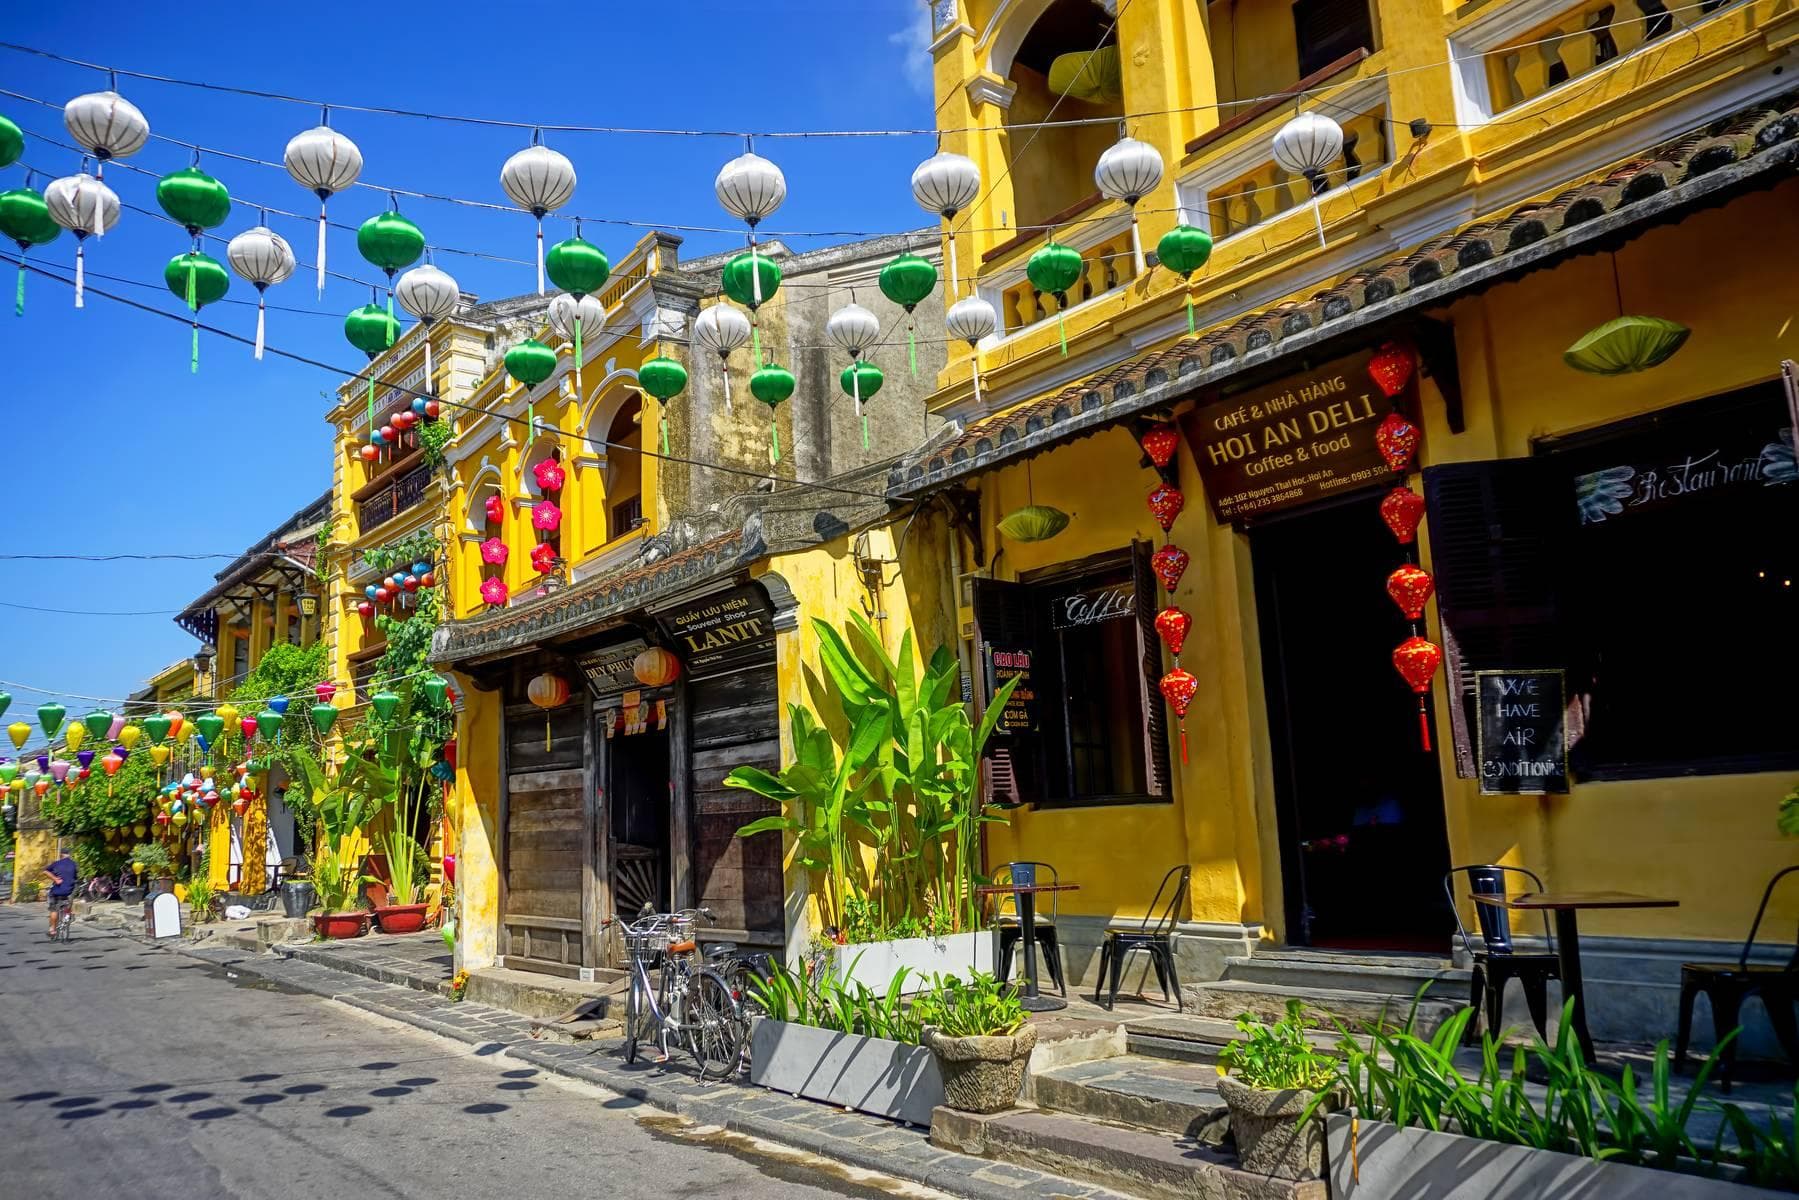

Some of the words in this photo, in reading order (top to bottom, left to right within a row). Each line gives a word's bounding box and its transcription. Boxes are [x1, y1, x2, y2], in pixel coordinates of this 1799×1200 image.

[1214, 407, 1249, 432] CAFÉ
[1251, 404, 1264, 420] &
[1265, 390, 1299, 415] NHÀ
[1299, 376, 1346, 402] HÀNG
[1208, 427, 1257, 466] HOI
[1264, 418, 1301, 450] AN
[1308, 394, 1377, 434] DELI
[1245, 454, 1294, 477] Coffee
[1296, 447, 1310, 462] &
[1311, 433, 1351, 458] food
[1256, 496, 1272, 508] 235
[1351, 469, 1372, 482] 0903
[723, 609, 747, 623] Shop
[684, 617, 763, 653] LANIT
[585, 664, 608, 680] DUY
[993, 652, 1013, 667] CAO
[1494, 678, 1541, 696] WE
[1496, 703, 1542, 718] HAVE
